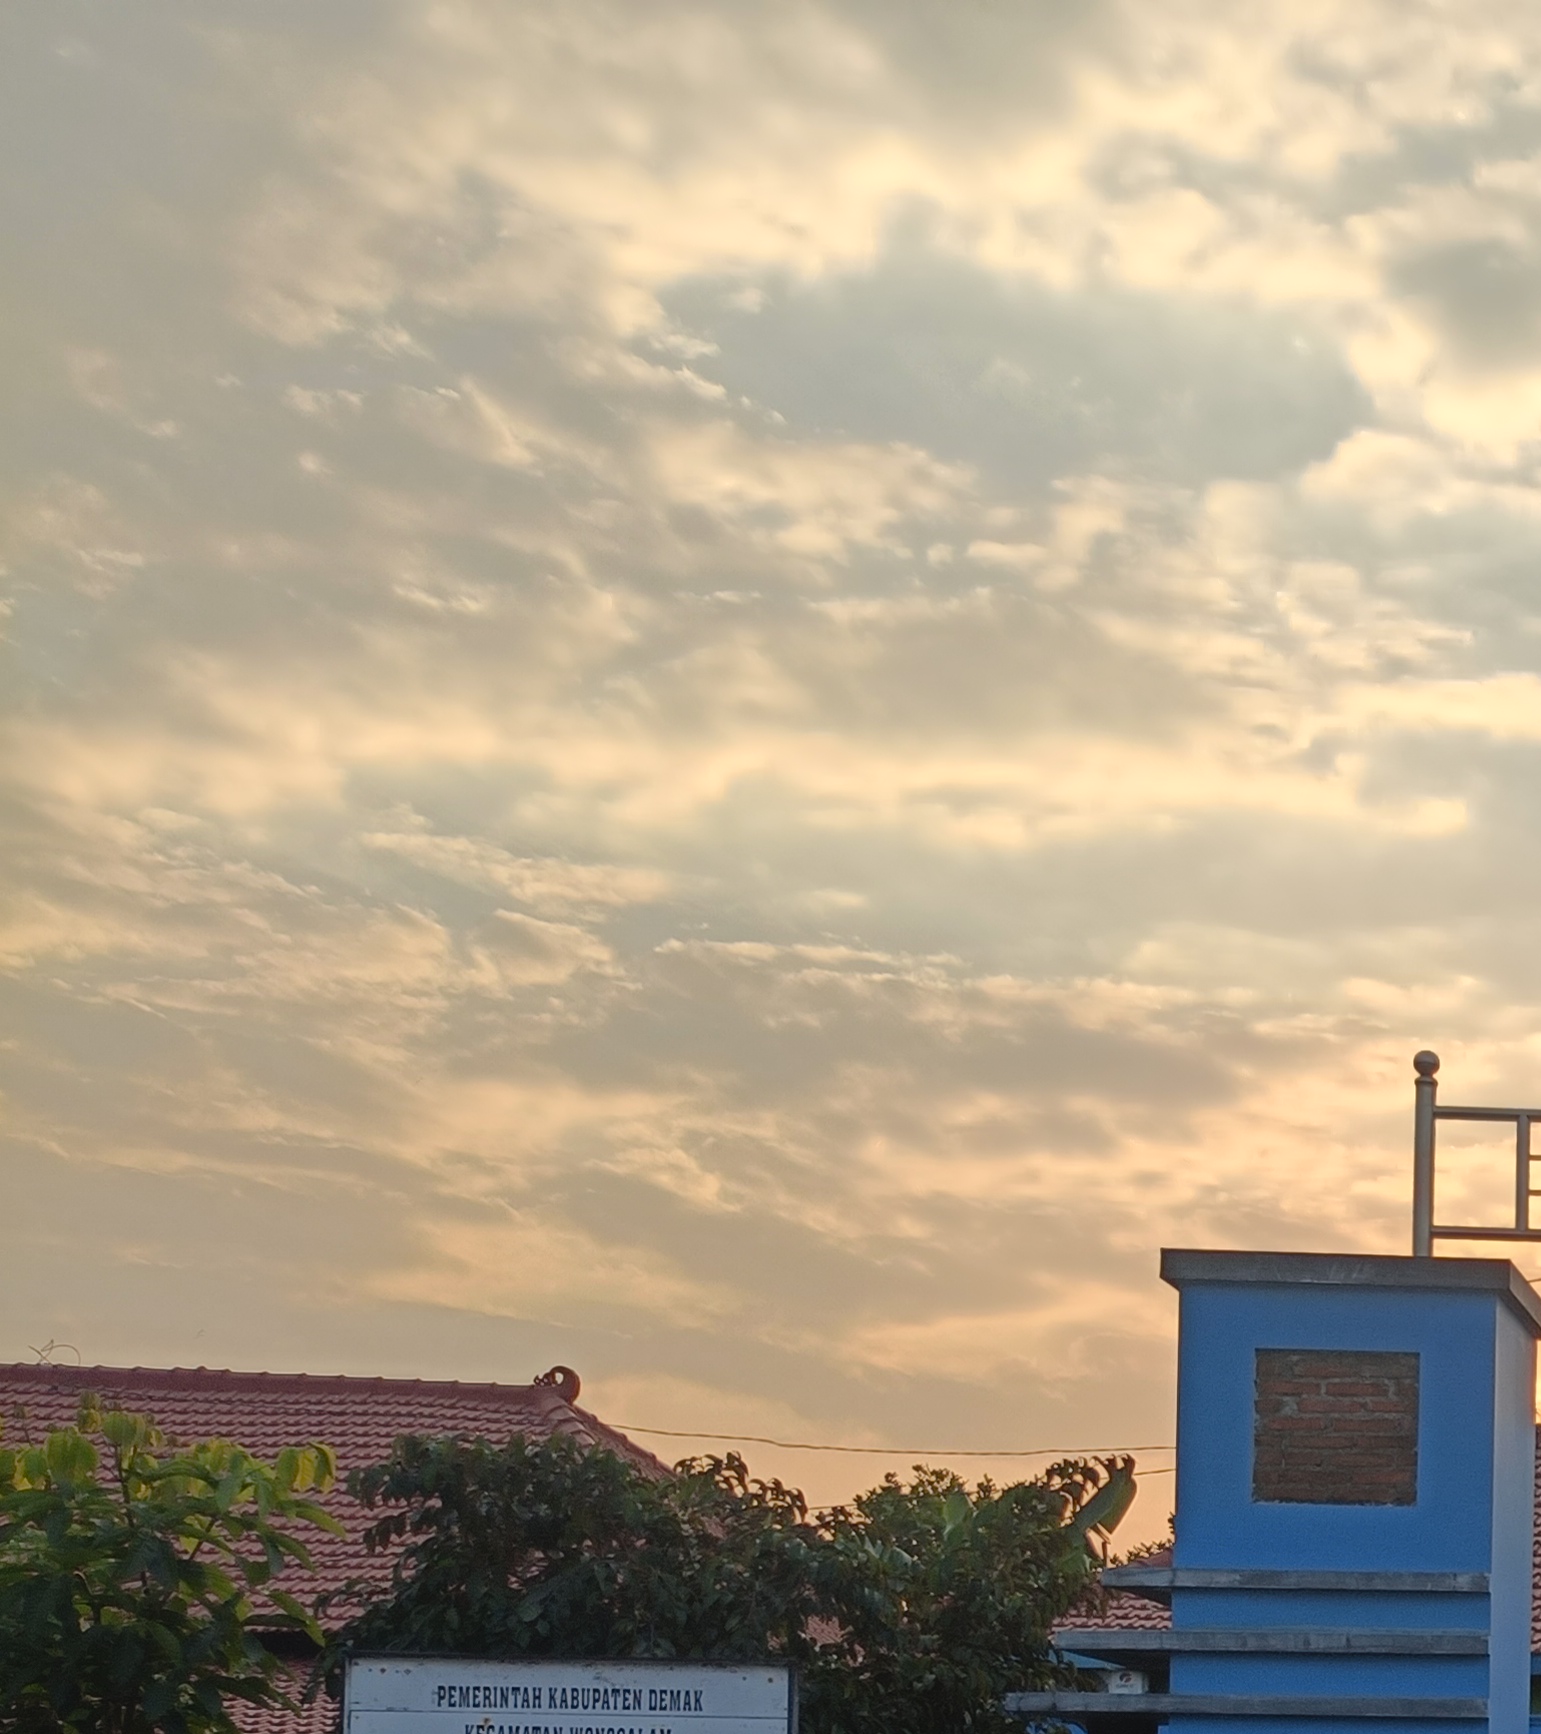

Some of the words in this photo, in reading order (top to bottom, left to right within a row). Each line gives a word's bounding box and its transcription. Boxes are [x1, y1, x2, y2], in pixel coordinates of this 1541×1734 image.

[436, 1685, 543, 1710] PEMERINTAH
[548, 1687, 643, 1711] KABUPATEN
[648, 1689, 704, 1713] DEMAK
